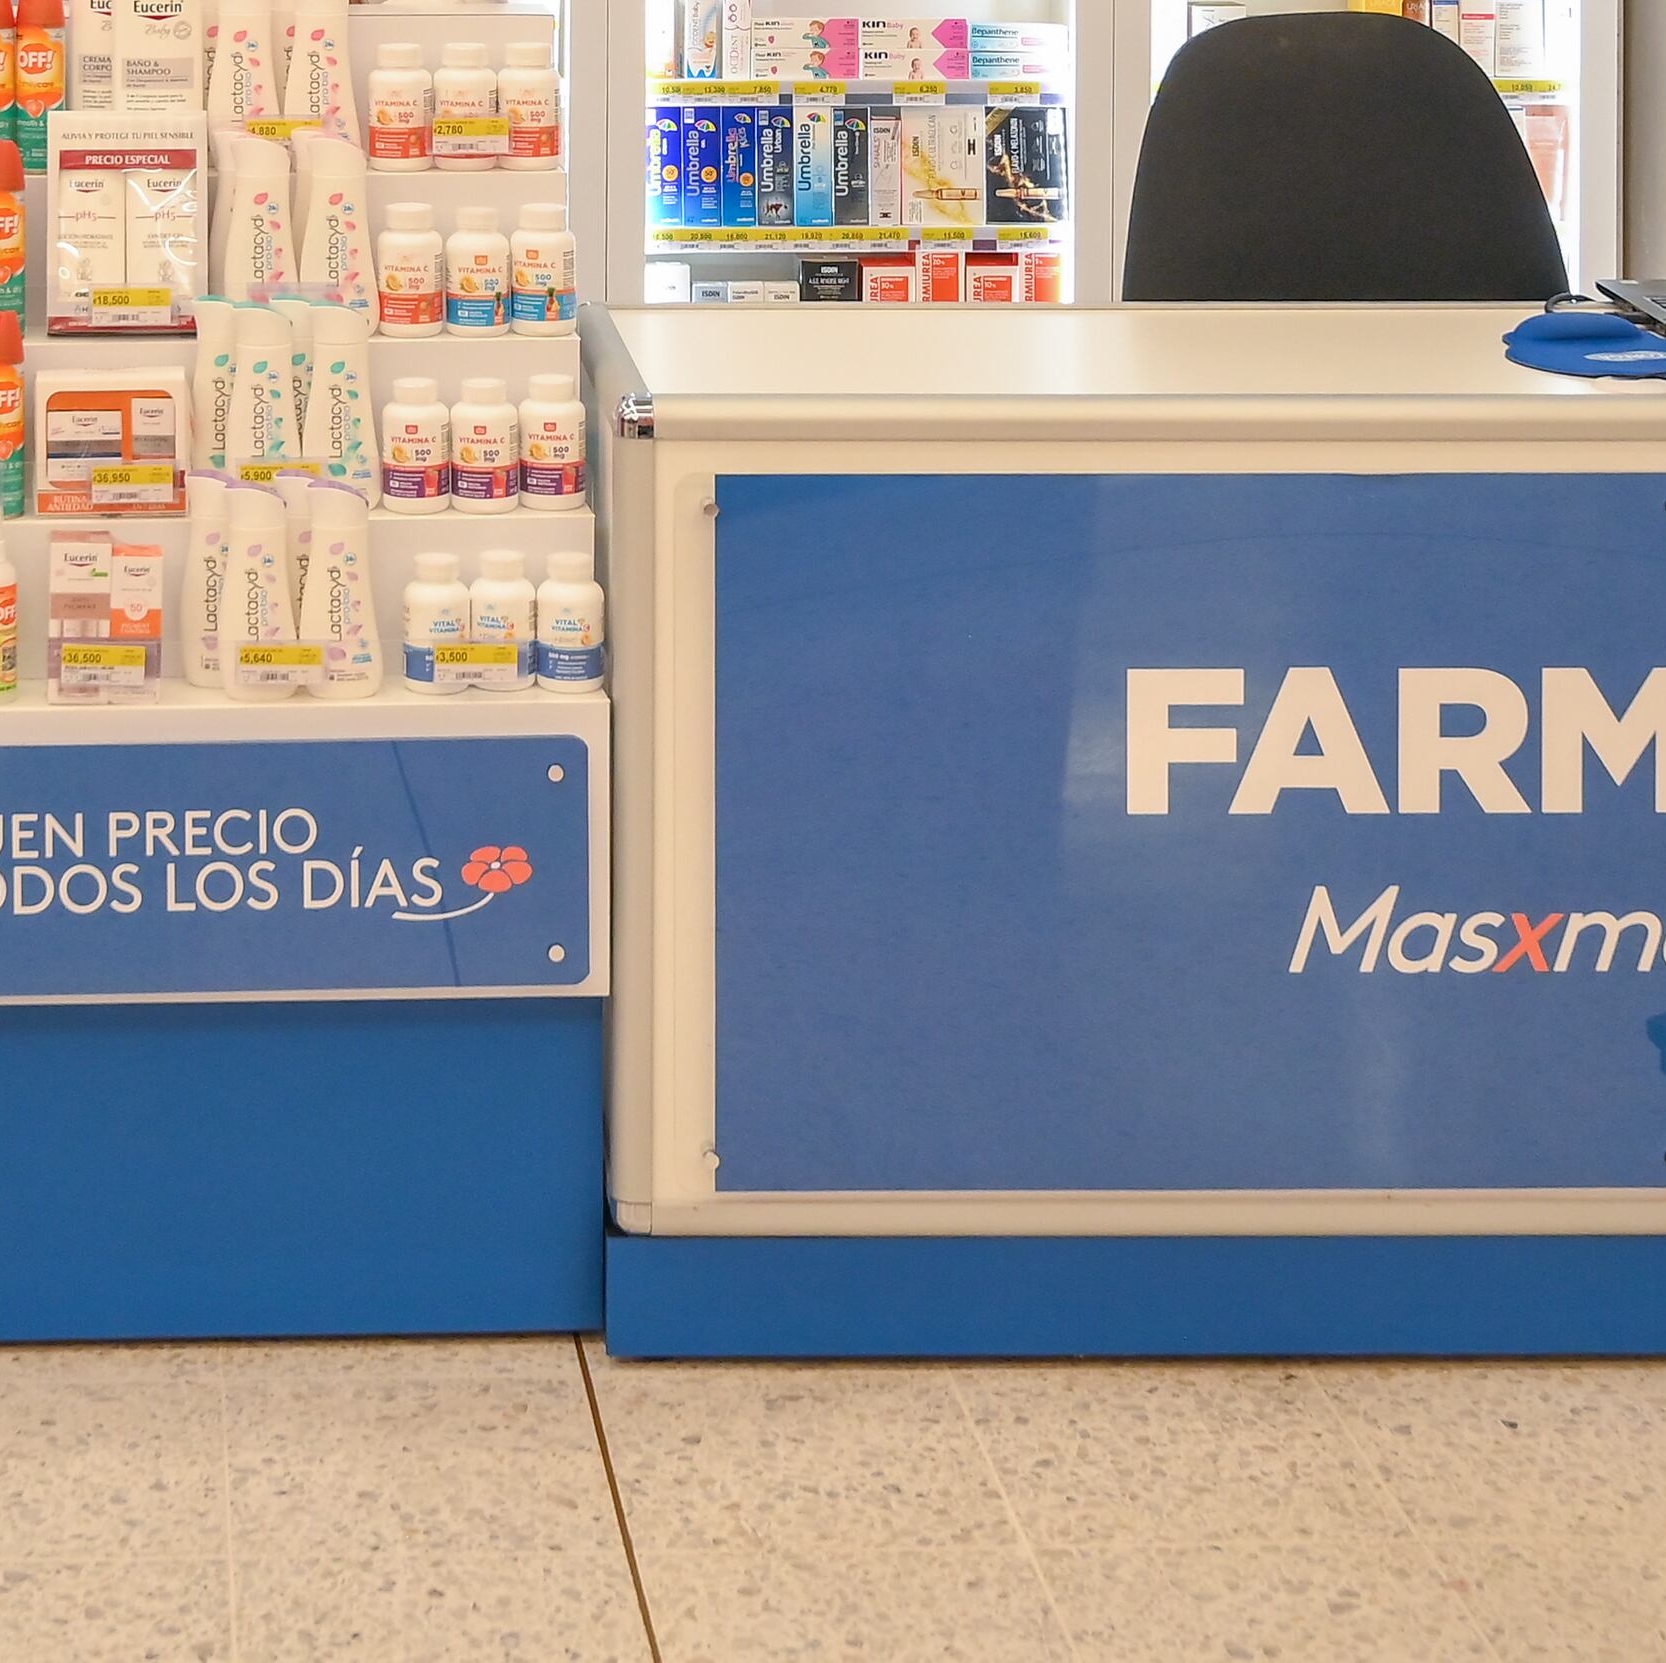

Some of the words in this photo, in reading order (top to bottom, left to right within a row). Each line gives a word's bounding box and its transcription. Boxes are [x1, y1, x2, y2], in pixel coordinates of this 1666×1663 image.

[133, 0, 182, 14] Eucerin
[971, 28, 1019, 38] Bepanthene
[18, 49, 55, 70] OFF!
[83, 56, 111, 64] CREMA
[126, 59, 149, 68] BAÑO
[126, 68, 171, 76] SHAMPOO
[231, 51, 249, 123] Lactacyd
[374, 99, 408, 107] VITAMINA
[410, 99, 418, 107] C
[398, 111, 414, 119] 500
[85, 156, 123, 165] PRECIO
[125, 155, 170, 164] ESPECIAL
[725, 127, 738, 183] Umbrella
[761, 128, 773, 193] Umbrella
[798, 123, 811, 192] Umbrella
[686, 130, 700, 197] Umbrella
[70, 179, 104, 188] Eucerin
[554, 618, 577, 627] VITAL
[109, 808, 318, 857] PRECIO
[166, 860, 279, 913] LOS
[302, 845, 444, 911] DÍAS
